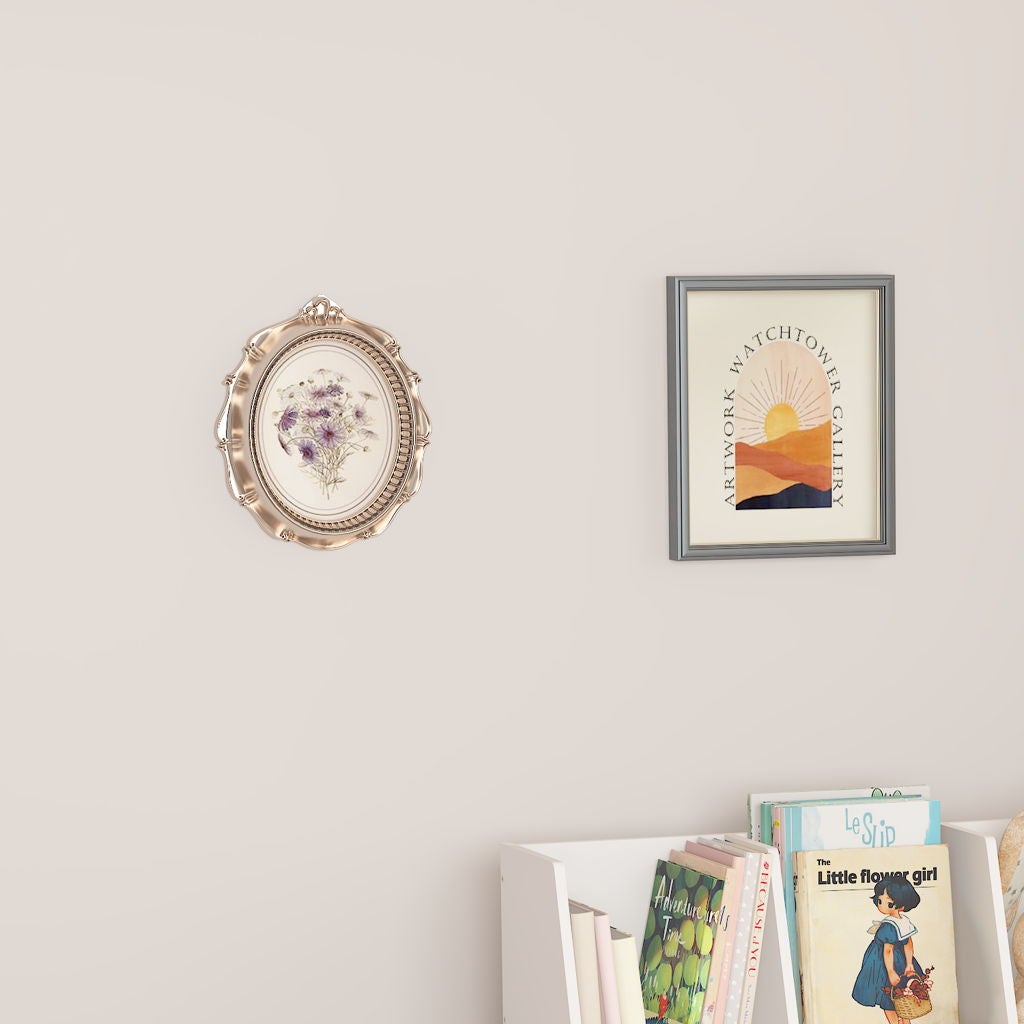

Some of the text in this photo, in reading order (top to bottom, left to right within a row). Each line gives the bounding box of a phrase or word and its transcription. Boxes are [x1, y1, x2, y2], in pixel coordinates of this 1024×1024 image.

[723, 325, 844, 507] ARTWORK WATCHTOWER GALLERY
[844, 807, 860, 835] Le
[816, 858, 831, 866] The
[817, 869, 858, 885] Little
[912, 866, 938, 886] girl
